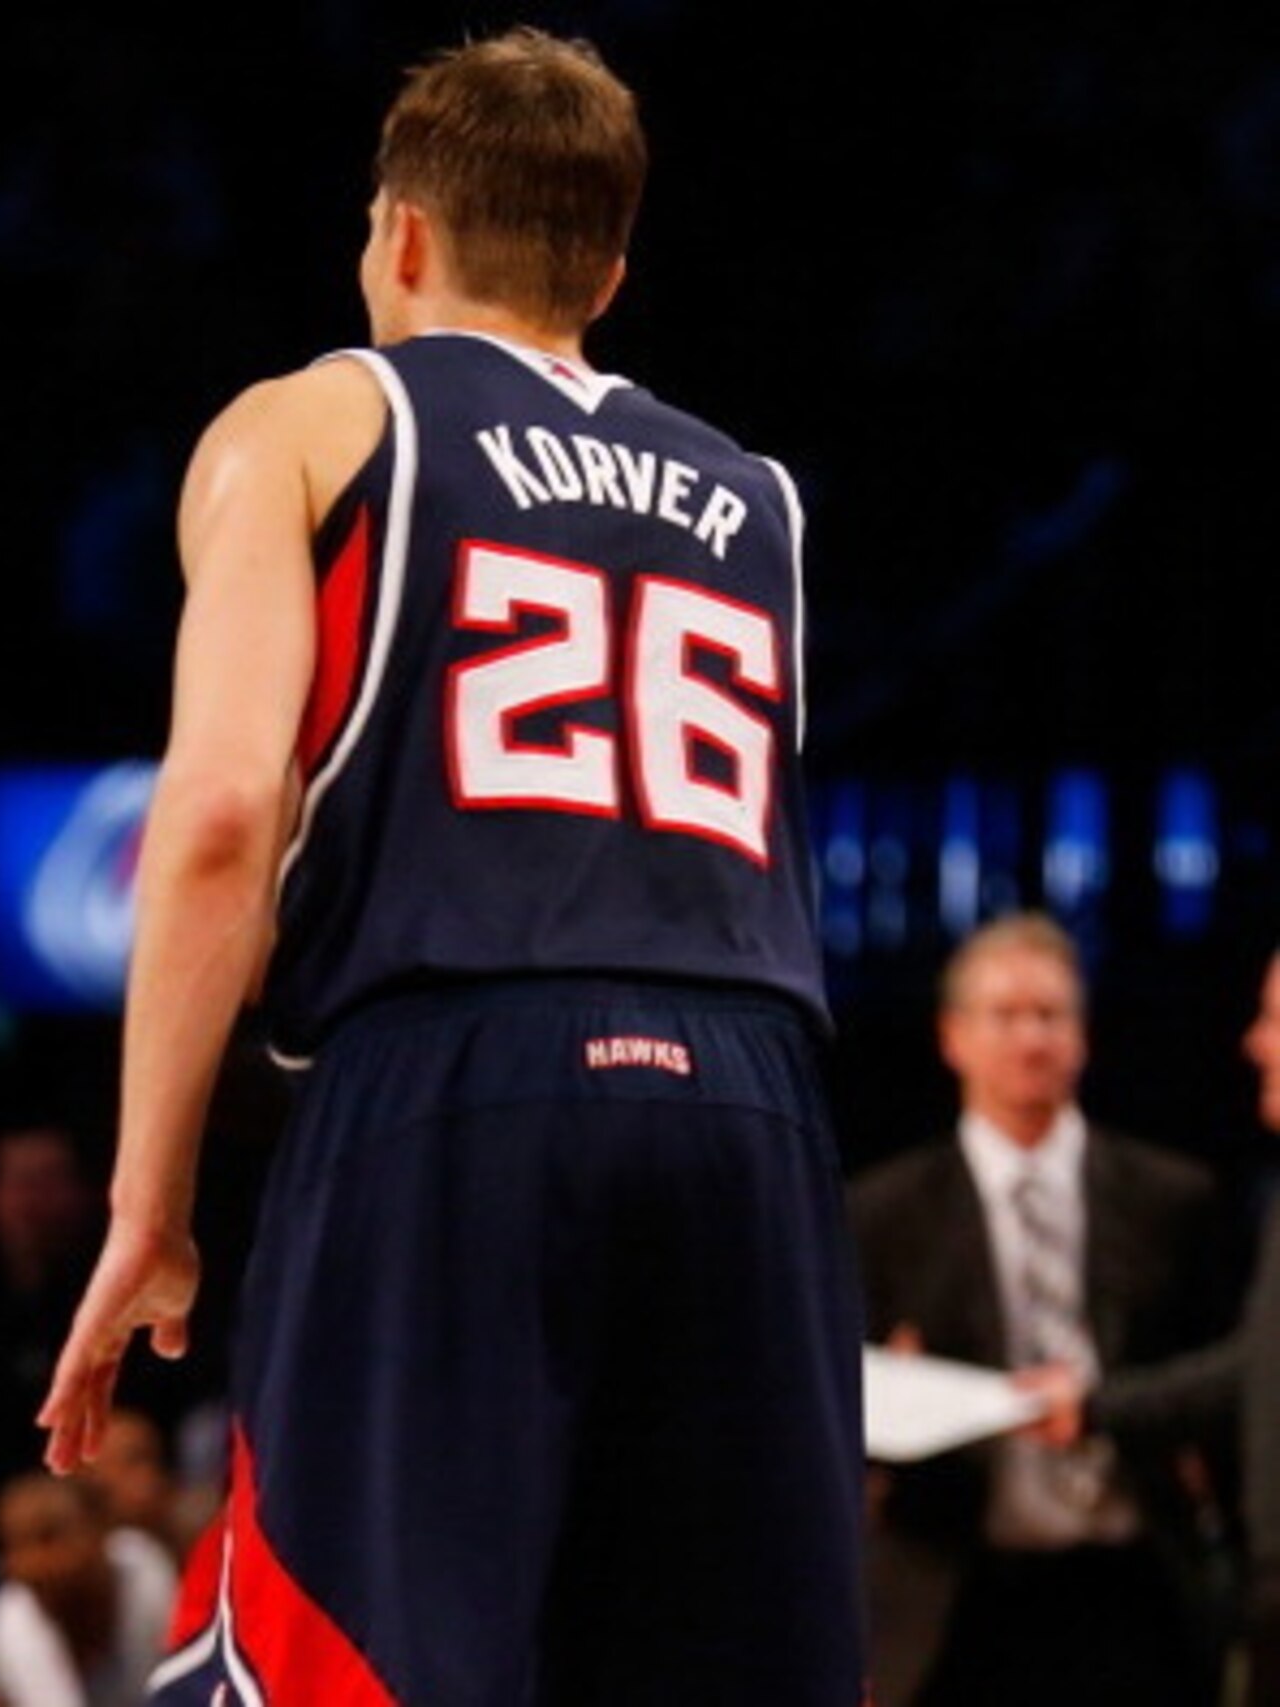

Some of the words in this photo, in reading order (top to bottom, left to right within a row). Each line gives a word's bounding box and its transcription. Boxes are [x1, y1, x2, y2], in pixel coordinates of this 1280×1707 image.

[477, 425, 748, 560] KORVER
[445, 538, 782, 870] 26
[584, 1036, 692, 1076] HAWKS
